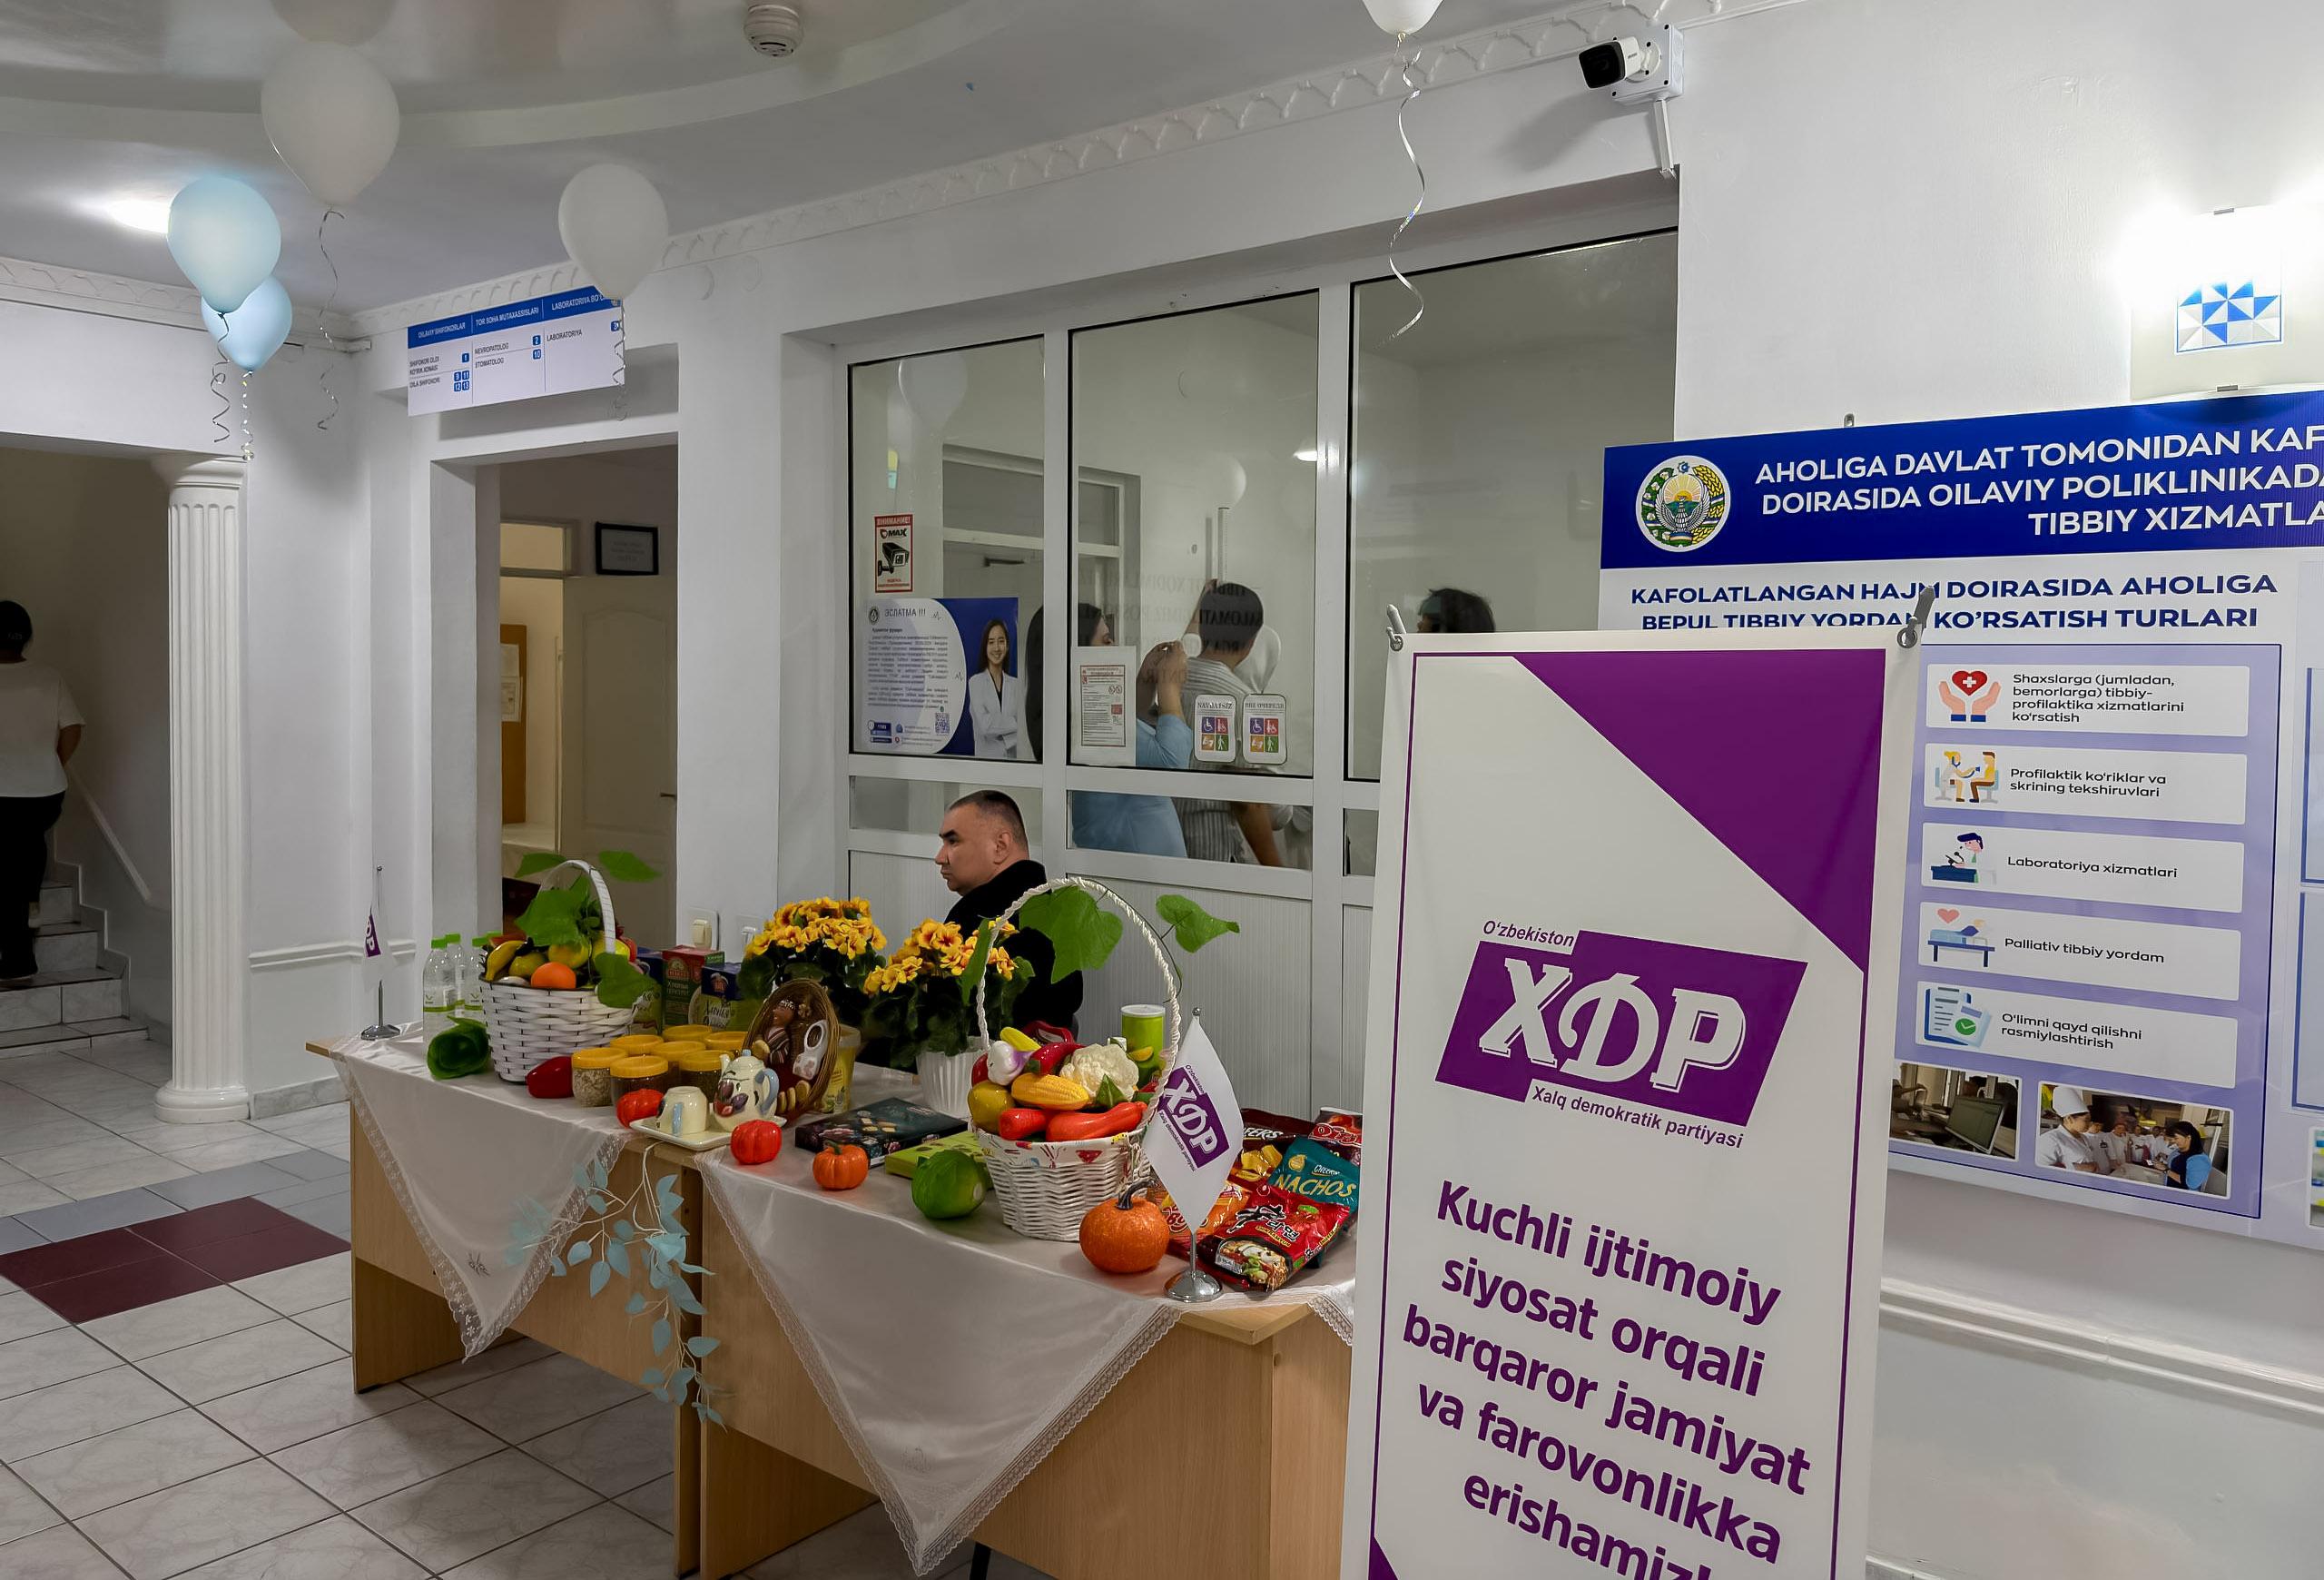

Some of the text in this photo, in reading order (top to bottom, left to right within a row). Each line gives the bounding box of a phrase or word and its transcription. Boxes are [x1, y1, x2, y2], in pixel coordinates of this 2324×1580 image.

[551, 297, 590, 311] LABORATORIYA
[476, 307, 539, 326] TOR SOHA MUTAXASSISLARI
[547, 330, 582, 341] LABORATORIYA
[475, 342, 508, 355] NEVROPATOLOG
[475, 351, 540, 369] STOMATOLOG 10
[455, 381, 469, 390] 12 13
[1756, 455, 1887, 485] AHOLIGA
[1895, 445, 2017, 477] DAVLAT
[2021, 430, 2245, 469] TOMONIDAN
[1762, 484, 1922, 516] DOIRASIDA
[1929, 476, 2058, 509] OILAVIY
[876, 516, 911, 525] ВНИМАНИЕ!
[2028, 499, 2324, 535] TIBBIY XIZMATLA
[1631, 583, 1856, 604] KAFOLATLANGAN
[1946, 576, 2113, 598] DOIRASIDA
[2120, 573, 2277, 596] AHOLIGA
[885, 609, 917, 617] ЭСЛАТМА
[1641, 614, 1718, 630] BEPUL
[1724, 612, 1807, 627] TIBBIY
[1810, 612, 1919, 627] YORDA
[2115, 607, 2257, 627] TURLARI
[2013, 674, 2175, 686] Shaxslarga (jumladan,
[2013, 686, 2153, 699] bemorlarga) tibbiy-
[2012, 699, 2185, 712] profilaktika xizmatlarini
[2010, 768, 2083, 781] Profilaktik
[2149, 775, 2166, 785] va
[2010, 781, 2160, 797] skrining tekshiruvlari
[2008, 856, 2177, 878] Laboratoriya xizmatlari
[2004, 938, 2164, 963] Palliativ tibbiy yordam
[1480, 957, 1746, 1094] XDP
[2053, 1018, 2089, 1034] qayd
[2092, 1021, 2142, 1039] qilishni
[2001, 1026, 2113, 1049] rasmiylashtirish
[1163, 1077, 1218, 1154] XDP
[1532, 1086, 1743, 1149] Xalq demokratik partiyasi
[1275, 1174, 1358, 1199] NACHOS
[1437, 1180, 1781, 1325] Kuchli ijtimoiy
[1442, 1257, 1765, 1397] siyosat orqali
[1403, 1304, 1810, 1495] barqaror jamiyat
[1418, 1384, 1780, 1564] va farovonlikka
